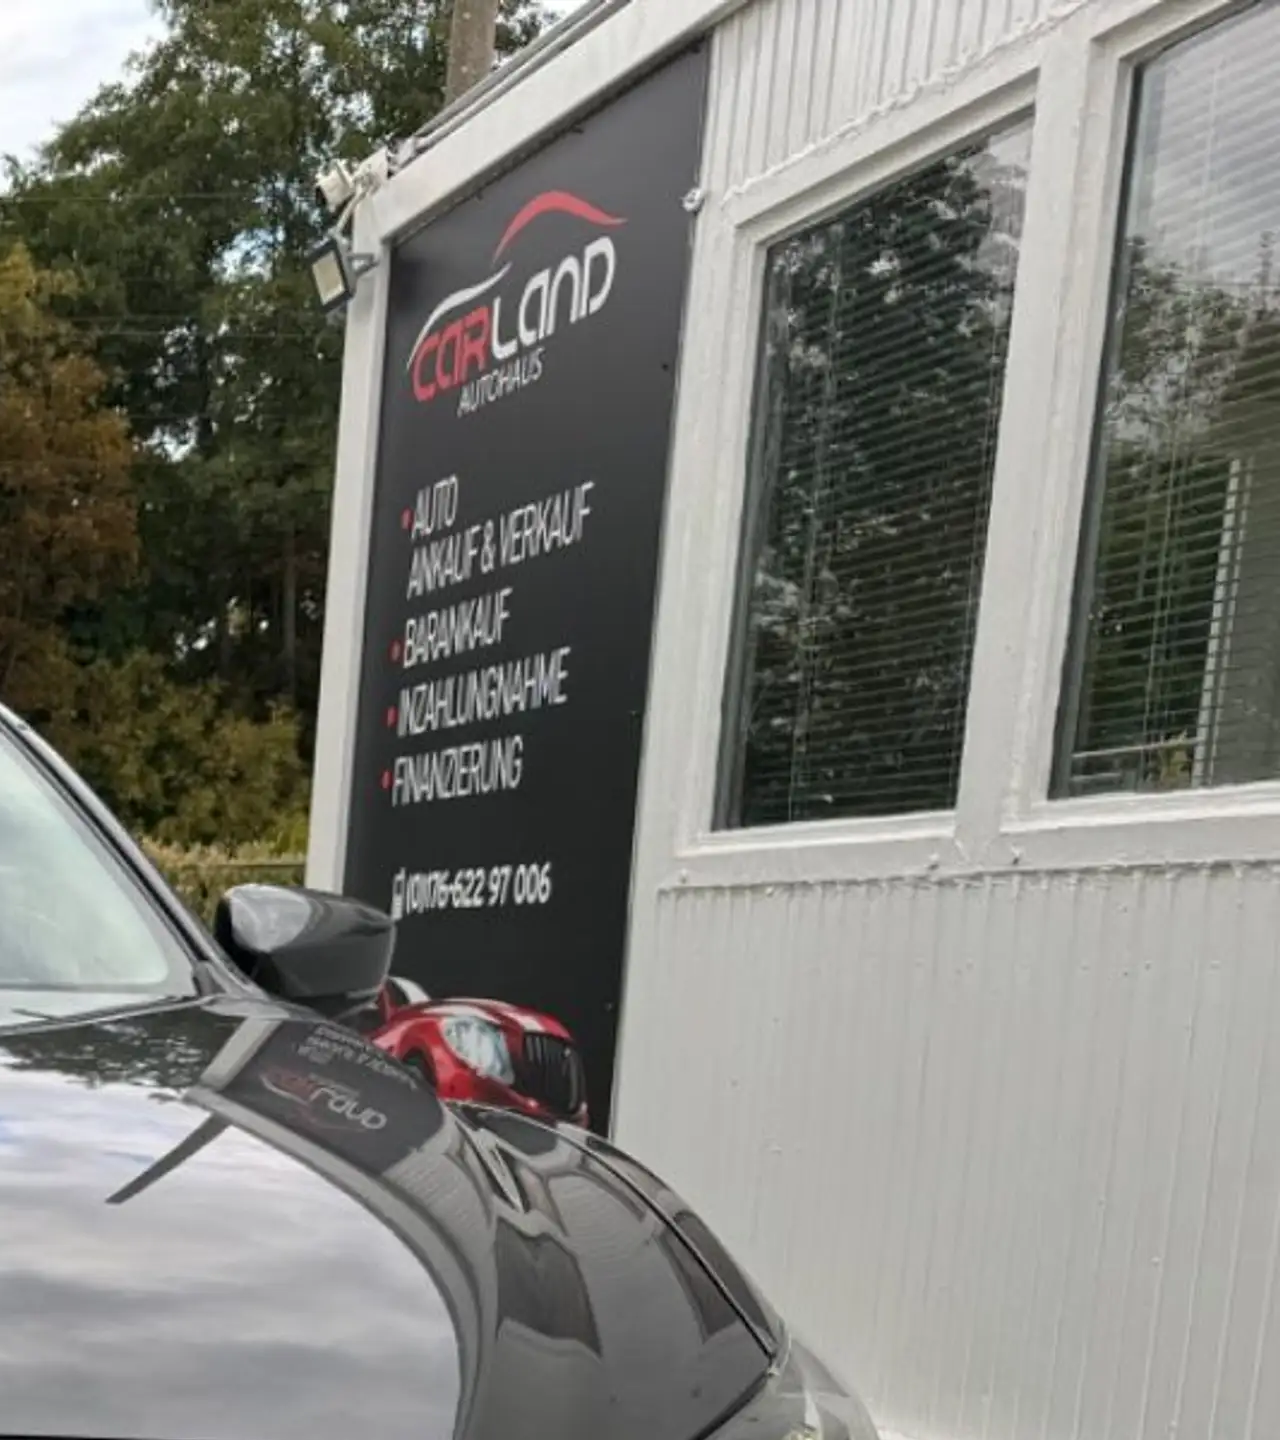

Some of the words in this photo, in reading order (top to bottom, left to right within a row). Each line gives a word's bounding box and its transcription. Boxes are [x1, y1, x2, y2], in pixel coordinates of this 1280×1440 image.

[413, 236, 615, 402] CARLAND
[457, 347, 545, 418] AUTOHAUS
[406, 525, 481, 600] ANKAUF
[481, 519, 495, 574] &
[499, 481, 595, 567] VERKAUF
[411, 474, 459, 542] AUTO
[403, 587, 513, 668] BARANKAUF
[397, 646, 571, 737] INZAHLUNGNAHME
[392, 735, 523, 807] FINANZIERUNG
[488, 864, 513, 907] 97
[513, 861, 552, 906] 006
